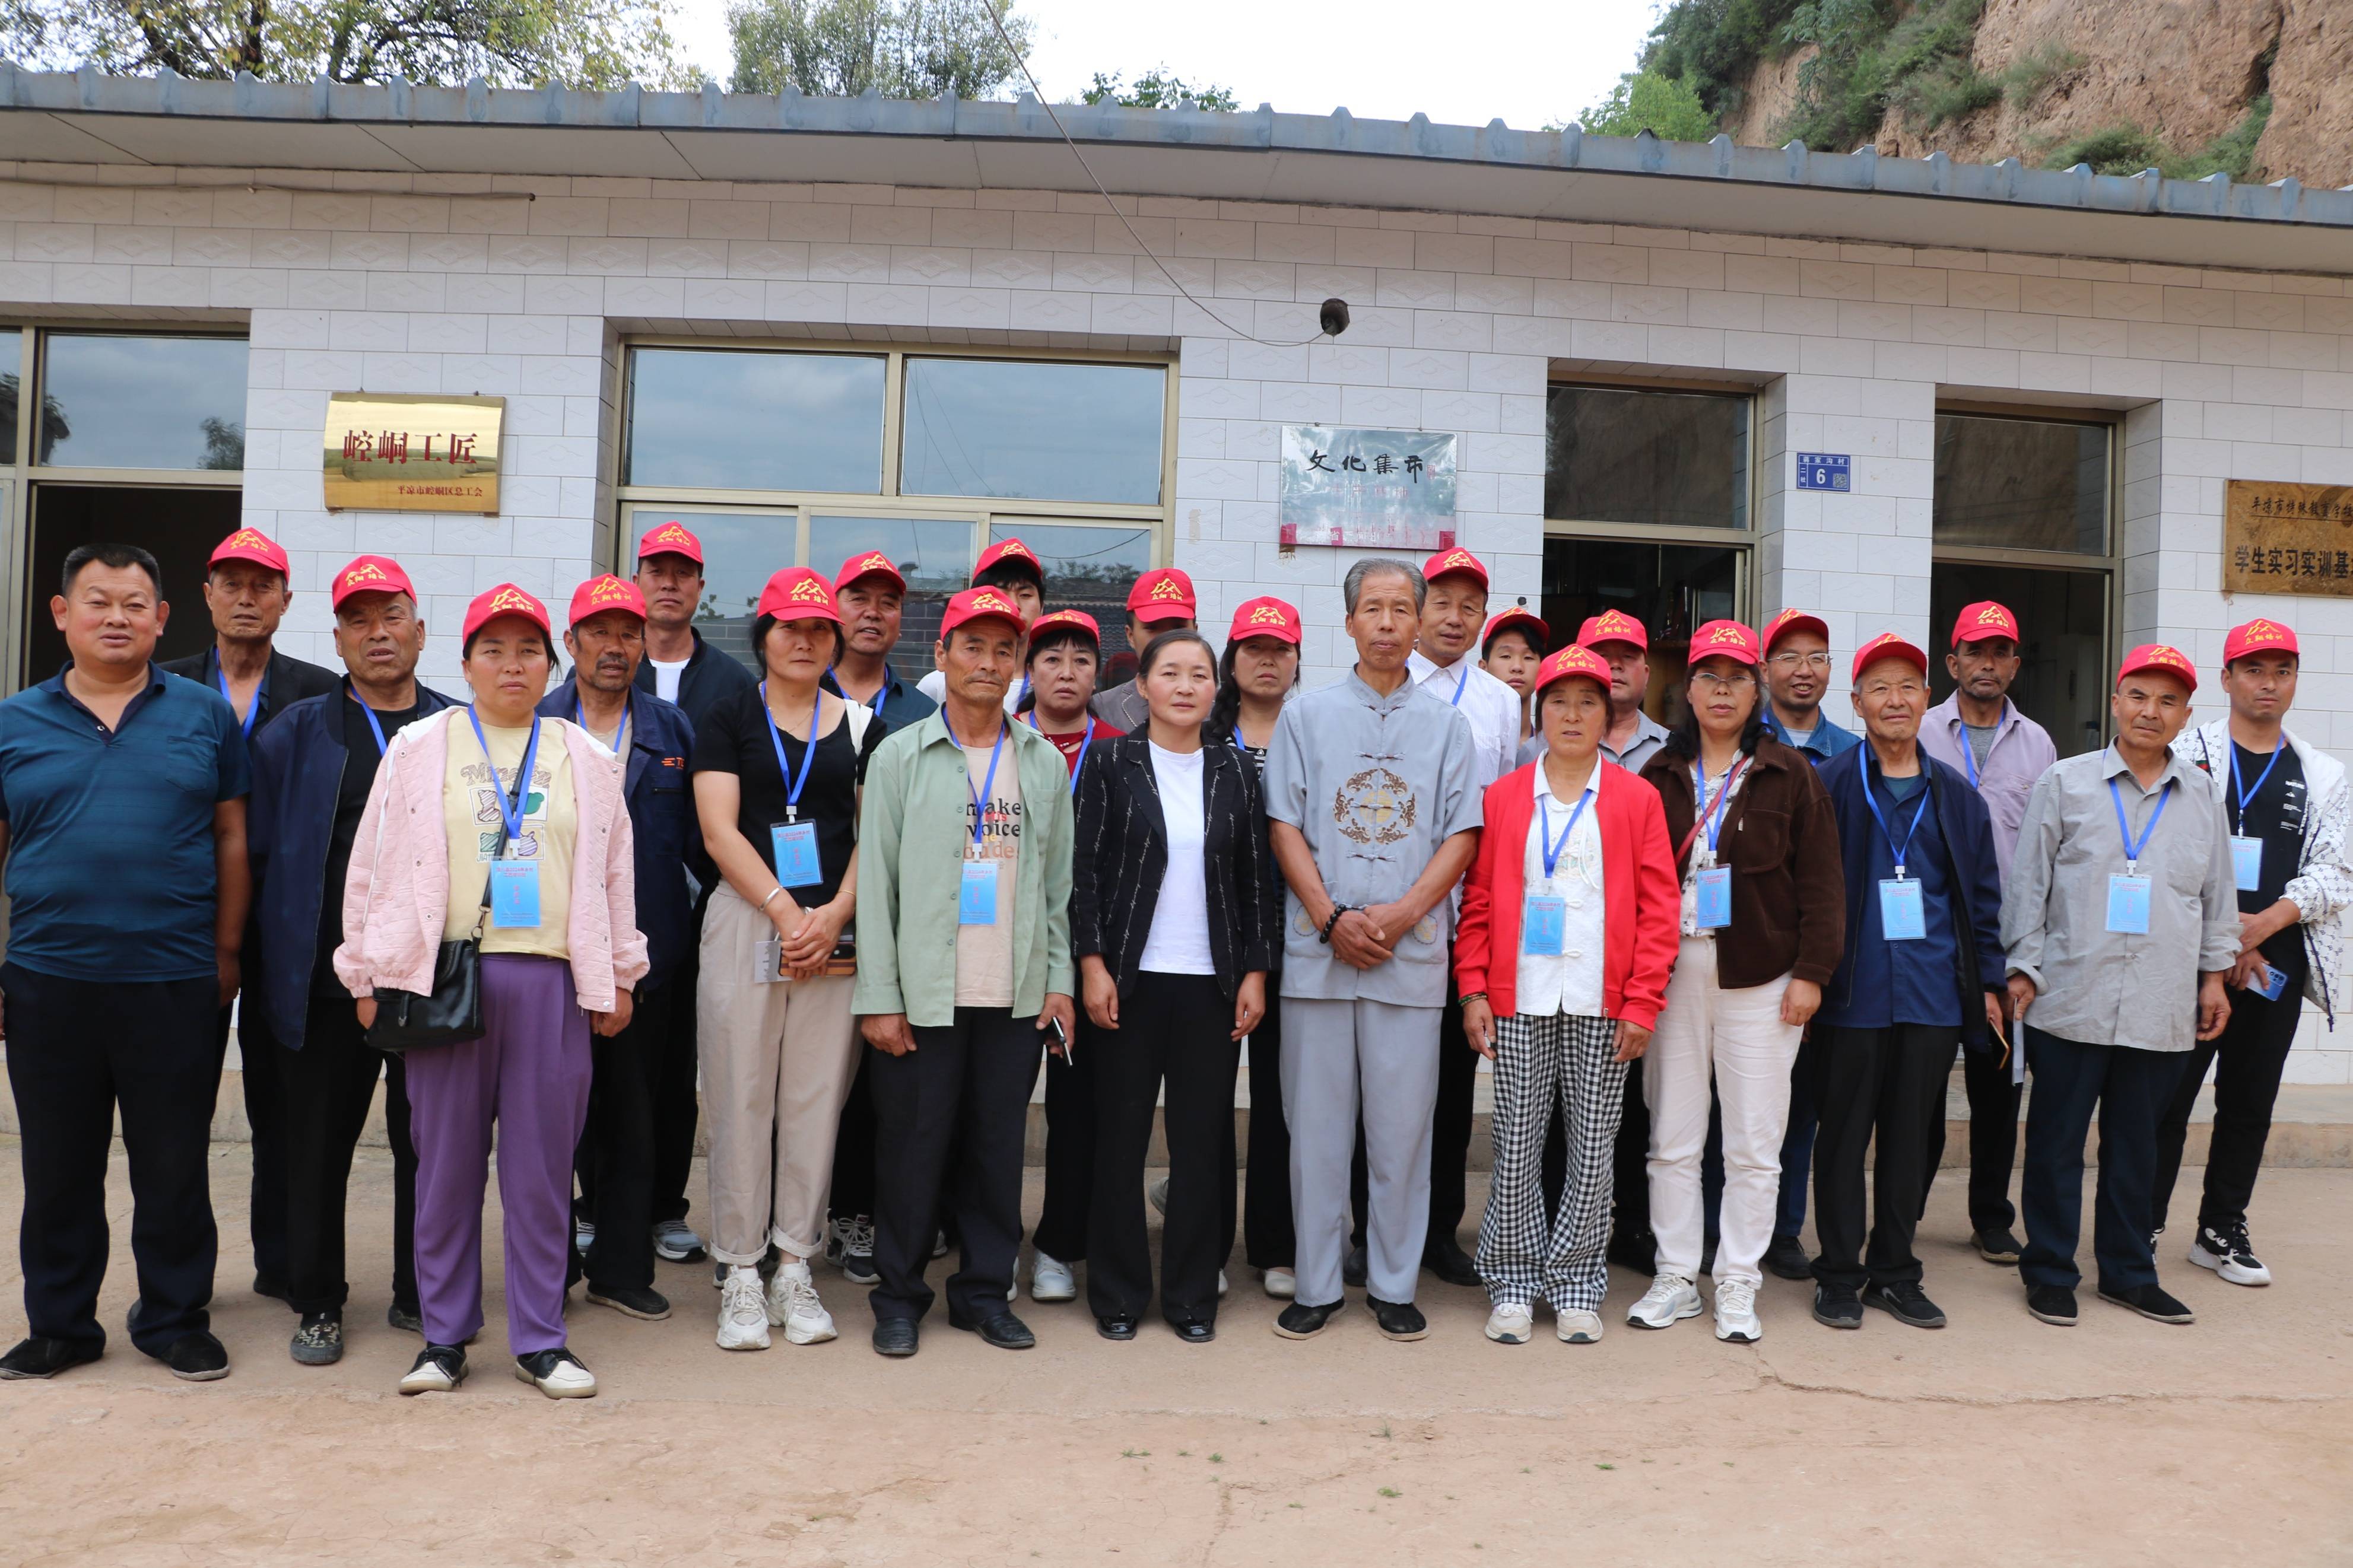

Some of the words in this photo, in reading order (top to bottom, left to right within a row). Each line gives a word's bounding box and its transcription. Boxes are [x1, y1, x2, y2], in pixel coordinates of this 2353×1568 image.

[342, 430, 478, 465] 崆峒工匠
[1306, 449, 1423, 484] 文化集市
[1816, 468, 1826, 484] 6
[398, 485, 483, 497] 平凉市崆峒区总工会
[2235, 545, 2353, 579] 学生实习实训基
